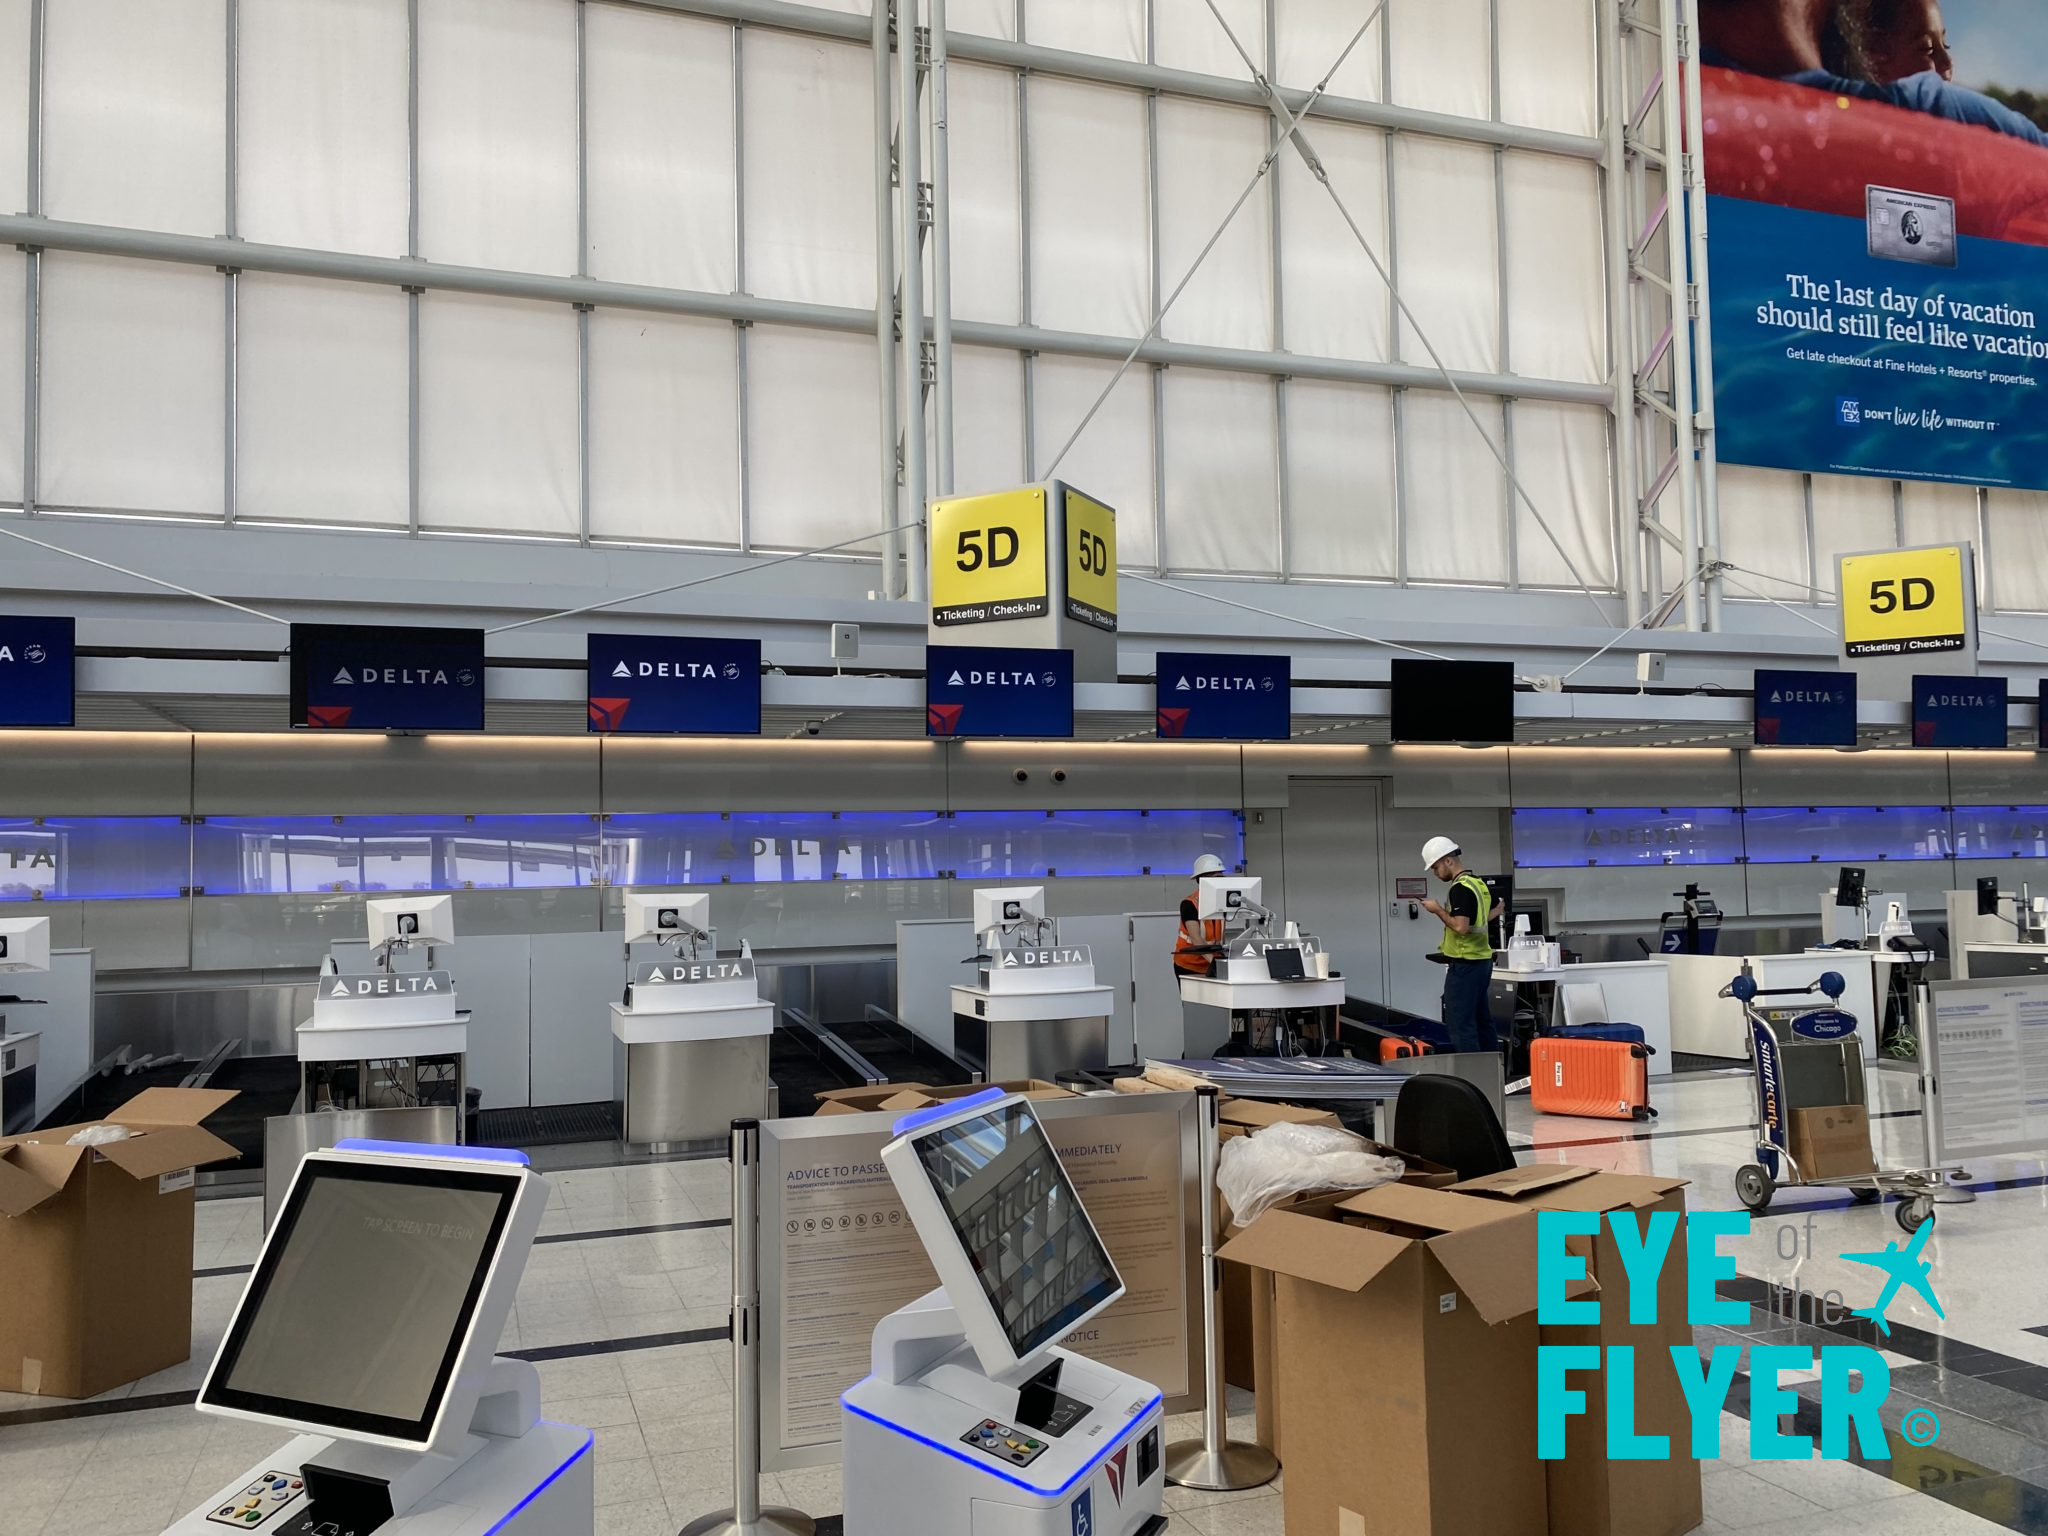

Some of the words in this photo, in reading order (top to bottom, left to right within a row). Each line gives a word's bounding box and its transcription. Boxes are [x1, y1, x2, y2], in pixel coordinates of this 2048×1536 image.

[1786, 273, 1831, 302] The
[1834, 280, 1875, 309] last
[1880, 287, 1918, 319] day
[1923, 294, 1945, 318] of
[1949, 301, 2036, 329] vacation
[1756, 301, 1834, 333] should
[1838, 313, 1881, 339] still
[1885, 317, 1925, 345] feel
[1930, 322, 1968, 350] like
[1972, 332, 2048, 360] vacatio
[1786, 347, 1805, 360] Get
[1806, 349, 1826, 362] late
[1827, 352, 1872, 368] checkout
[1873, 359, 1884, 369] at
[1885, 359, 1906, 372] Fine
[1907, 362, 1938, 375] Hotels
[1989, 373, 2038, 386] properties.
[1864, 409, 1892, 421] DON'T
[1894, 406, 1920, 427] live
[1921, 408, 1944, 431] life
[1945, 417, 1985, 430] WITHOUT
[956, 526, 1019, 572] 5D
[1079, 528, 1107, 577] 5D
[1869, 577, 1935, 614] 5D
[942, 607, 985, 621] Ticketing
[993, 602, 1036, 616] Check-In
[1073, 604, 1093, 621] Ticketing
[1856, 641, 1901, 653] Ticketing
[1909, 638, 1954, 650] Check-In
[363, 668, 448, 685] DELTA
[639, 662, 716, 678] DELTA
[970, 671, 1036, 686] DELTA
[1196, 676, 1256, 690] DELTA
[1785, 691, 1831, 703] DELTA
[1941, 695, 1984, 706] DELTA
[1024, 950, 1082, 964] DELTA
[673, 963, 743, 981] DELTA
[357, 976, 438, 994] DELTA
[1814, 1025, 1842, 1033] Chicago
[1055, 1143, 1122, 1159] MMEDIATELY
[787, 1167, 830, 1181] ADVICE
[833, 1166, 849, 1177] TO
[852, 1163, 887, 1175] PASSE
[361, 1216, 383, 1232] TAP
[382, 1217, 424, 1234] SCREEN
[425, 1222, 440, 1236] TO
[440, 1223, 474, 1241] BEGIN
[1061, 1329, 1100, 1344] NOTICE
